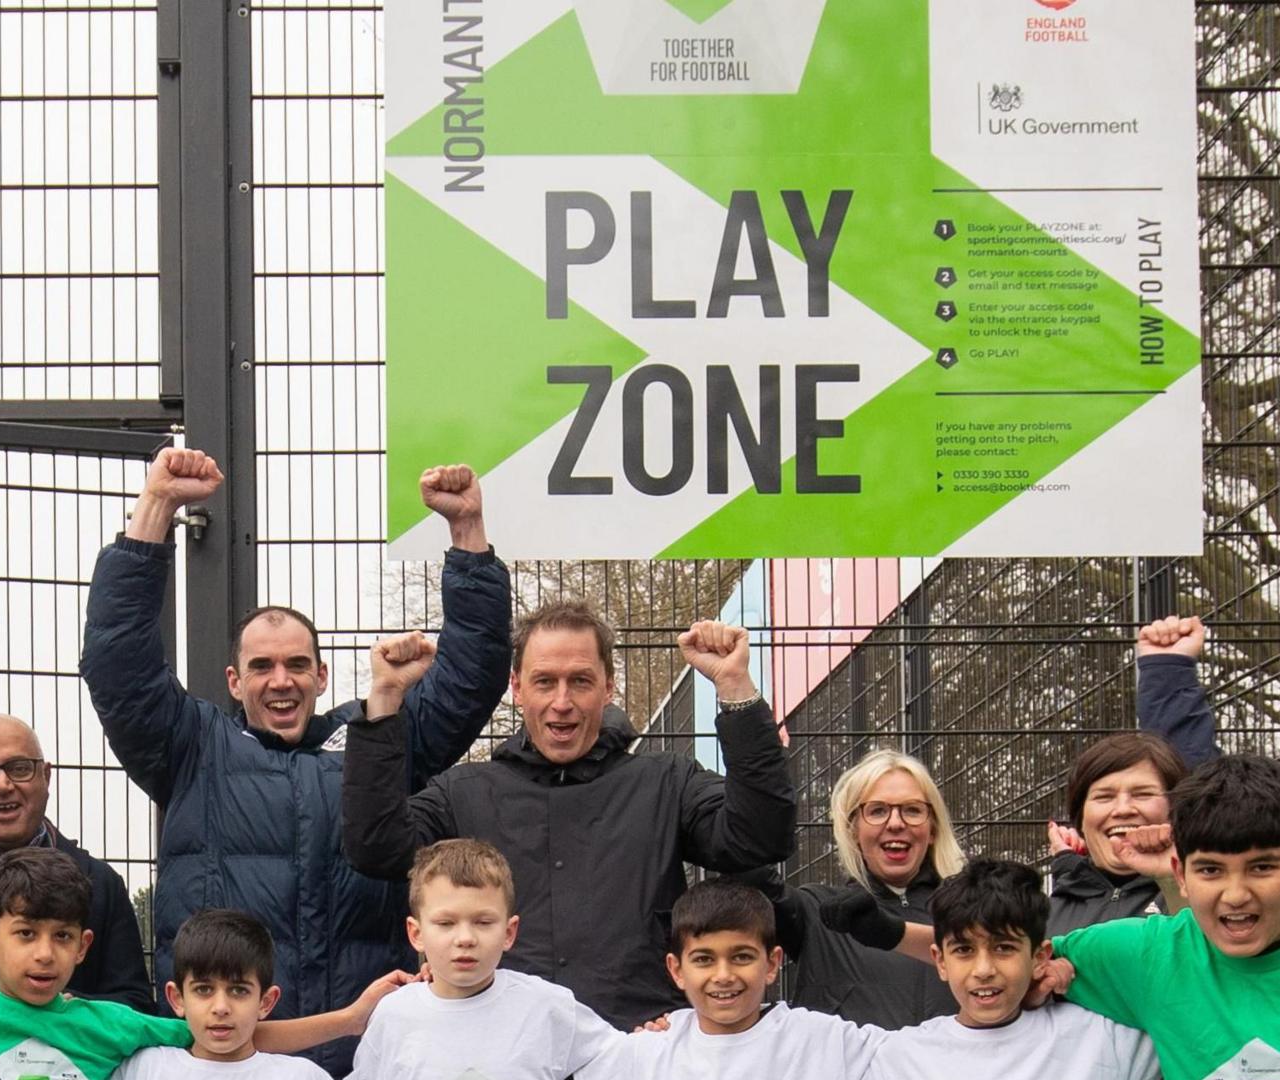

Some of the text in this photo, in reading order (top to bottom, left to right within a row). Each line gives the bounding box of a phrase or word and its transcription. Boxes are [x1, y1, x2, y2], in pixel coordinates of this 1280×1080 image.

[1026, 17, 1087, 29] ENGLAND
[1025, 30, 1089, 42] FOOTBALL
[663, 38, 735, 59] TOGETHER
[650, 61, 750, 82] FOR FOOTBALL
[988, 118, 1139, 135] UK Government
[942, 222, 1102, 235] 1 Book your PLAYZONE at:
[545, 189, 854, 319] PLAY
[968, 247, 1068, 256] normanton-courts
[941, 268, 1099, 282] 2 Get your access code by
[968, 281, 1098, 292] email and text message
[1138, 217, 1164, 365] HOW TO PLAY
[942, 305, 950, 316] 3
[969, 303, 998, 312] Enter
[1000, 305, 1025, 314] your
[1069, 302, 1094, 311] code
[969, 314, 1100, 326] via the entrance keypad
[969, 327, 1069, 338] to unlock the gate
[941, 349, 1019, 362] 4 Go PLAY!
[547, 363, 861, 496] ZONE
[936, 421, 1071, 433] If you have any problems
[936, 434, 1058, 446] getting onto the pitch,
[936, 447, 1018, 458] please contact:
[953, 470, 1029, 479] 0330 390 3330
[953, 482, 1070, 493] access@bookteq.com
